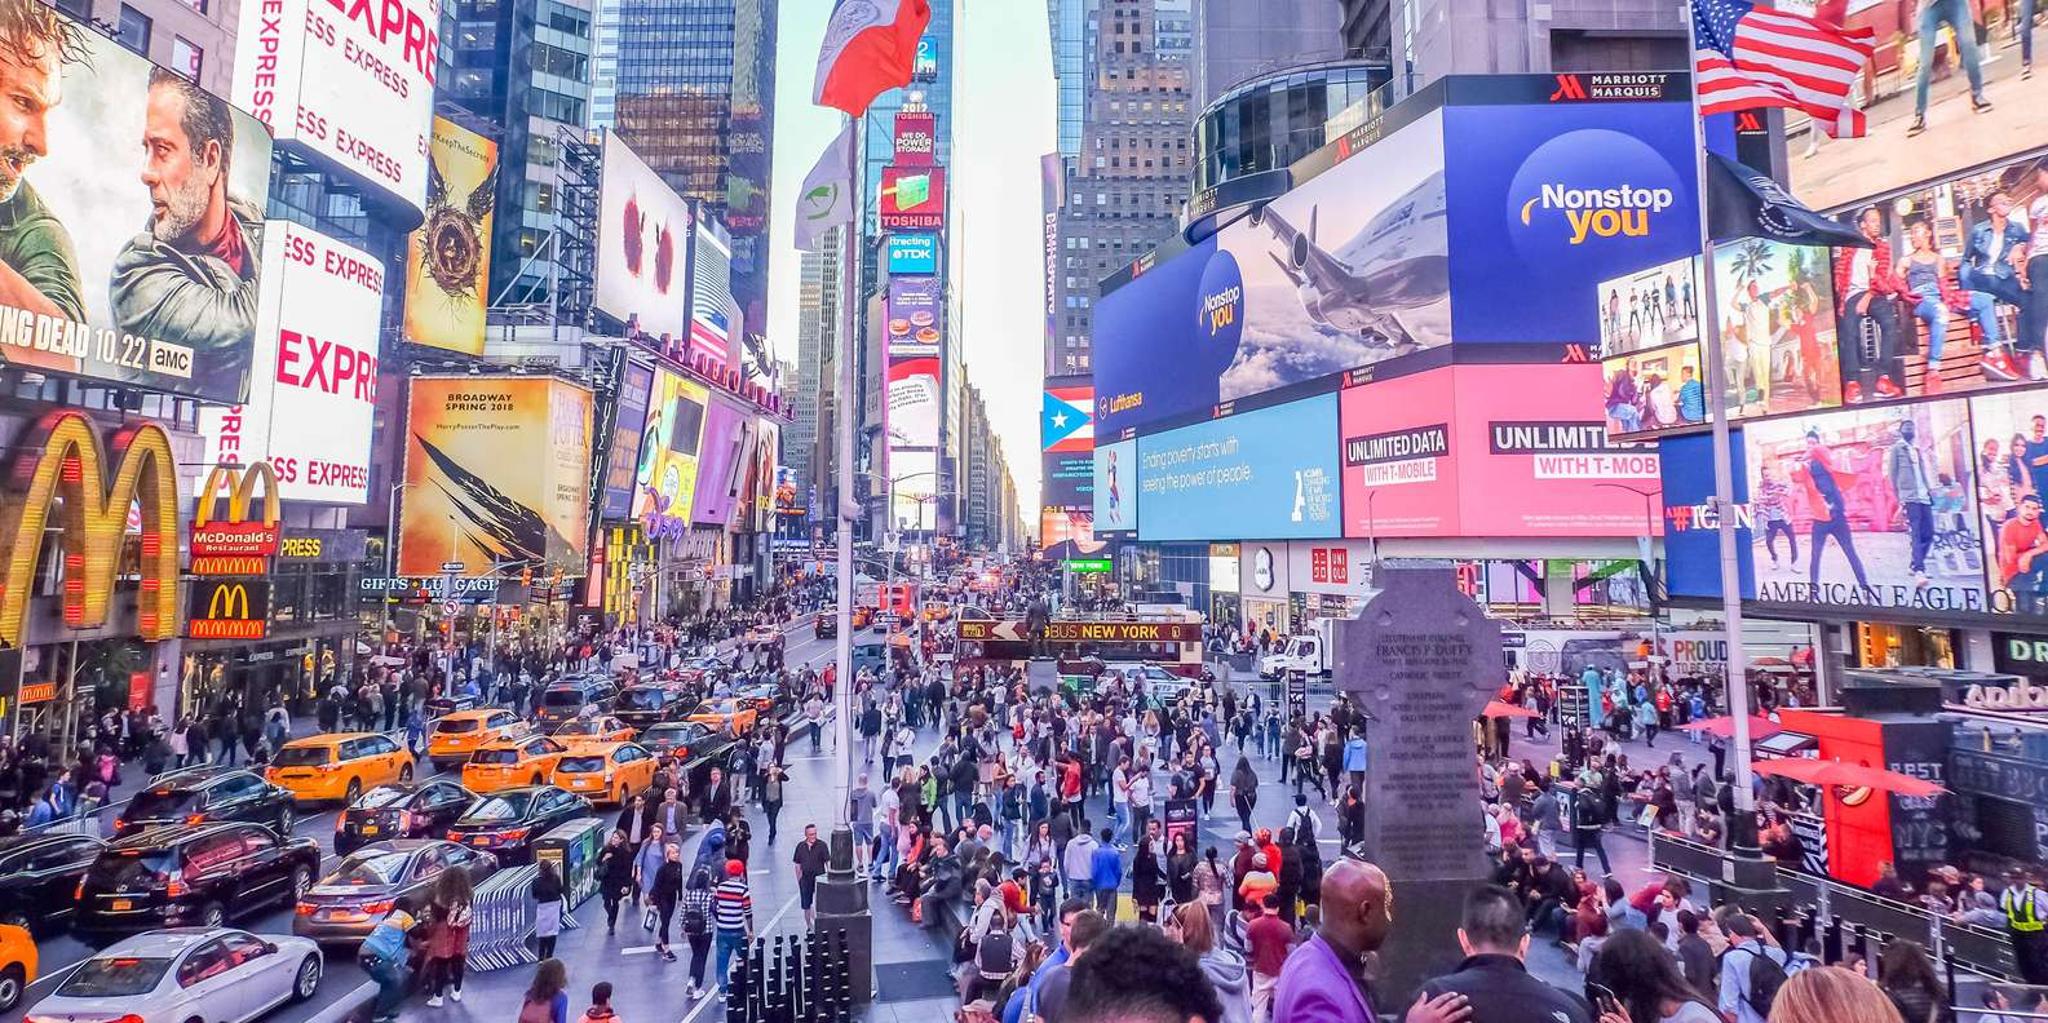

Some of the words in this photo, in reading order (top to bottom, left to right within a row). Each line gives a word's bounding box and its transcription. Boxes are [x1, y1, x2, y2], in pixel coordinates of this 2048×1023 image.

[326, 0, 439, 84] XPRE
[344, 37, 409, 98] EXPRESS
[1592, 74, 1667, 85] MARRIOTT
[1592, 86, 1660, 97] MARQUIS
[896, 138, 932, 147] POWER
[336, 129, 402, 184] EXPRESS
[1541, 184, 1673, 213] Nonstop
[882, 215, 942, 227] TOSHIBA
[1565, 208, 1649, 245] you
[901, 249, 931, 259] TDK
[325, 250, 382, 296] EXPRESS
[1204, 286, 1240, 313] Nonstop
[1210, 304, 1233, 336] you
[34, 313, 90, 359] DEAD
[95, 328, 148, 369] 10.22
[445, 403, 487, 411] SPRING
[490, 403, 514, 411] 2018
[447, 393, 513, 402] BROADWAY
[1110, 392, 1142, 414] Lufthansa
[1348, 435, 1411, 462] UNLIMITED
[1411, 429, 1446, 454] DATA
[267, 456, 297, 483] SS
[308, 460, 367, 489] EXPRESS
[1366, 465, 1389, 483] WITH
[1389, 460, 1434, 480] T-MOBILE
[1539, 457, 1588, 474] WITH
[1593, 457, 1658, 474] T-MOB
[193, 532, 274, 543] McDonald's
[206, 544, 259, 552] Restaurant
[361, 578, 408, 590] GIFTS
[1759, 581, 1883, 607] AMERICAN
[1890, 586, 1982, 612] EAGLE
[1082, 626, 1116, 638] NEW
[1120, 626, 1160, 638] YORK
[1674, 640, 1728, 661] PROUD
